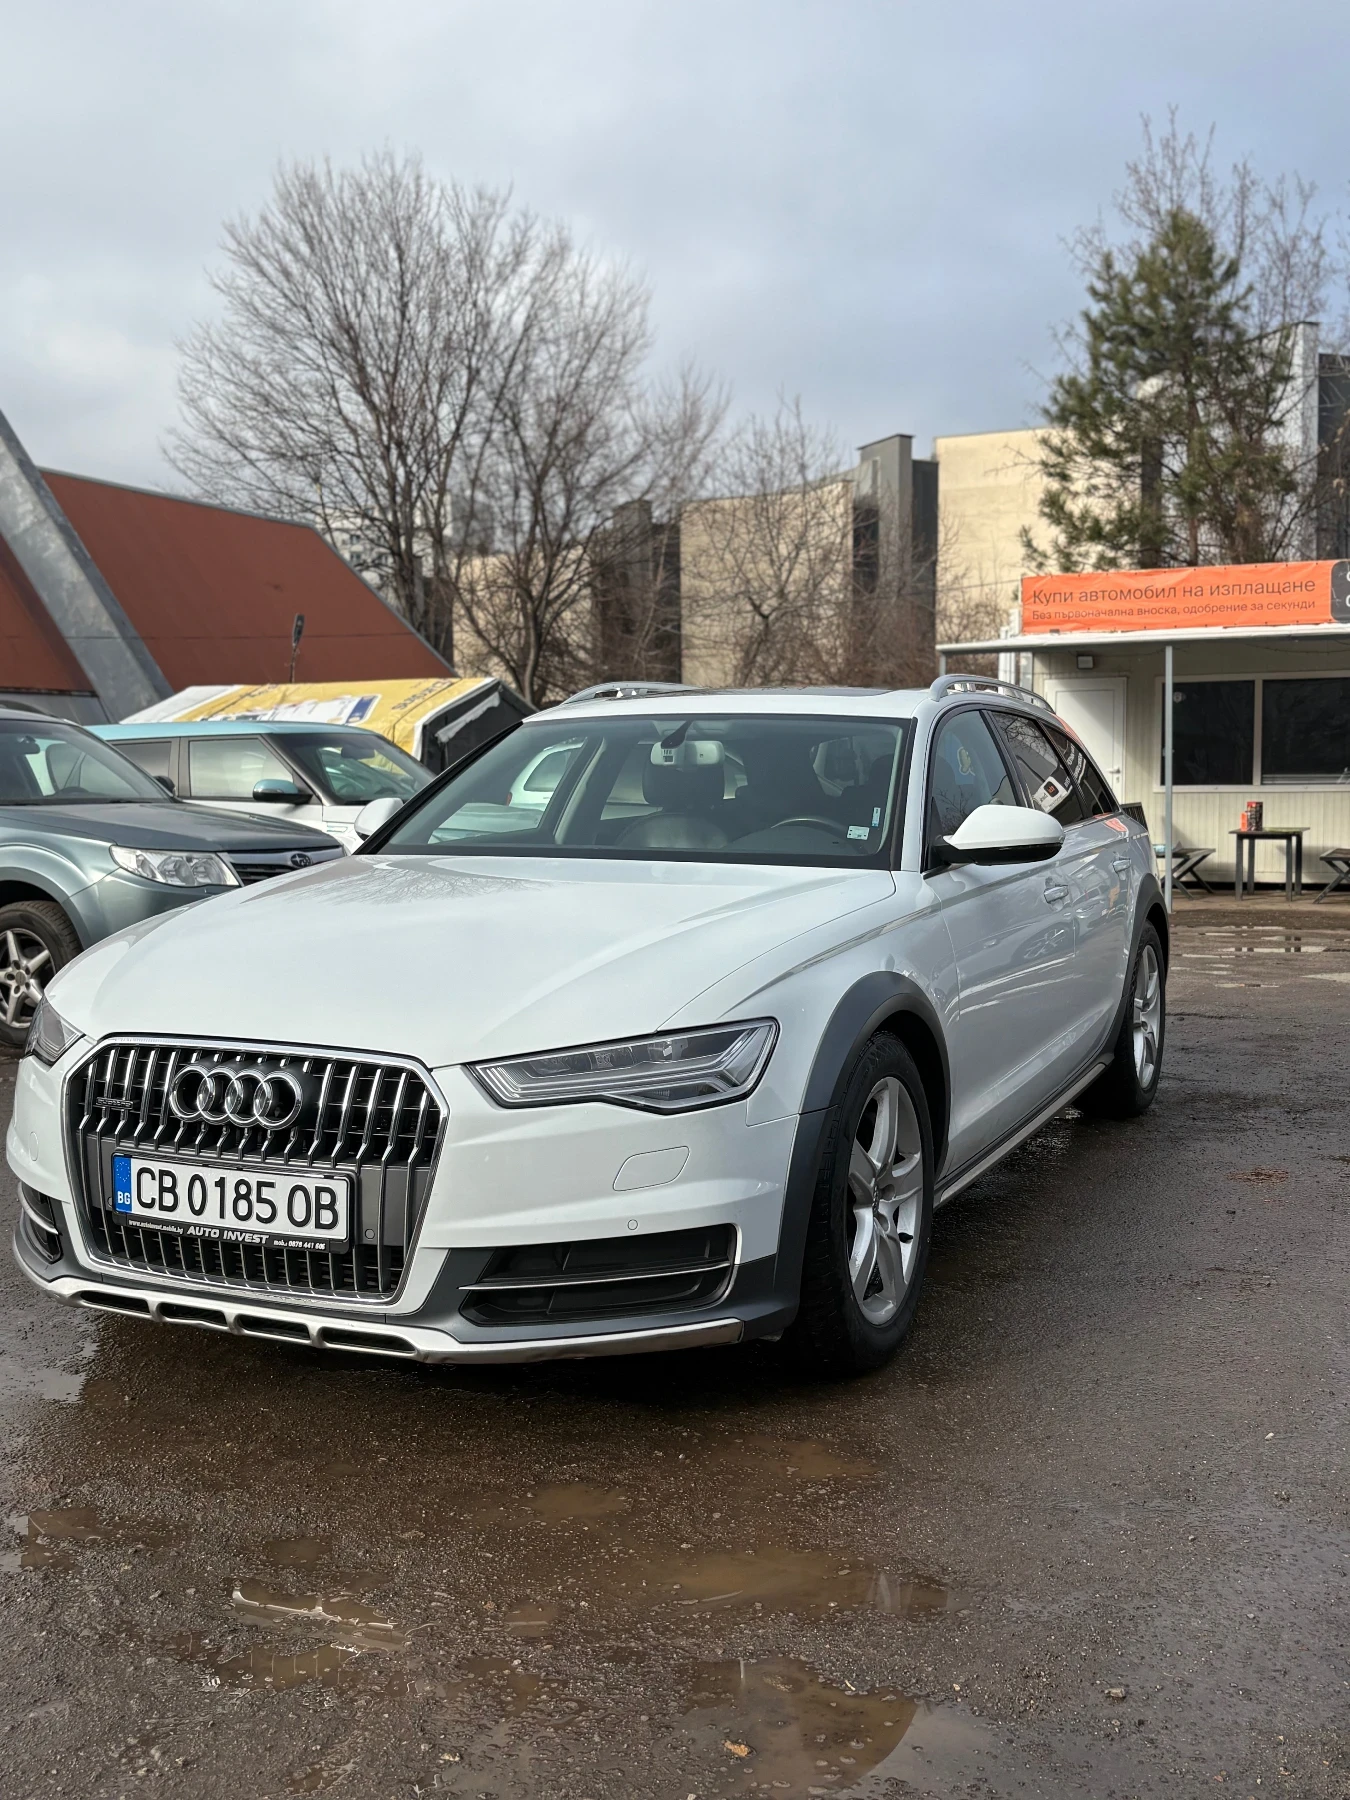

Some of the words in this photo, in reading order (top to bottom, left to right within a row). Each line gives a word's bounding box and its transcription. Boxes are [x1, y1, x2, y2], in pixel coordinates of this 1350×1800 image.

[1033, 589, 1073, 606] Купи
[1078, 585, 1177, 602] автомобил
[1182, 585, 1204, 598] на
[1209, 580, 1316, 596] изплащане
[1032, 610, 1052, 620] Без
[1054, 608, 1134, 620] първоначална
[1136, 606, 1180, 616] вноска,
[1182, 603, 1248, 615] одобрение
[1250, 602, 1264, 611] за
[1266, 600, 1316, 611] секунди
[117, 1190, 131, 1205] BG
[136, 1166, 179, 1213] CB
[187, 1173, 277, 1224] 0185
[287, 1183, 339, 1230] OB
[187, 1226, 220, 1238] AUTO
[223, 1230, 269, 1244] INVEST
